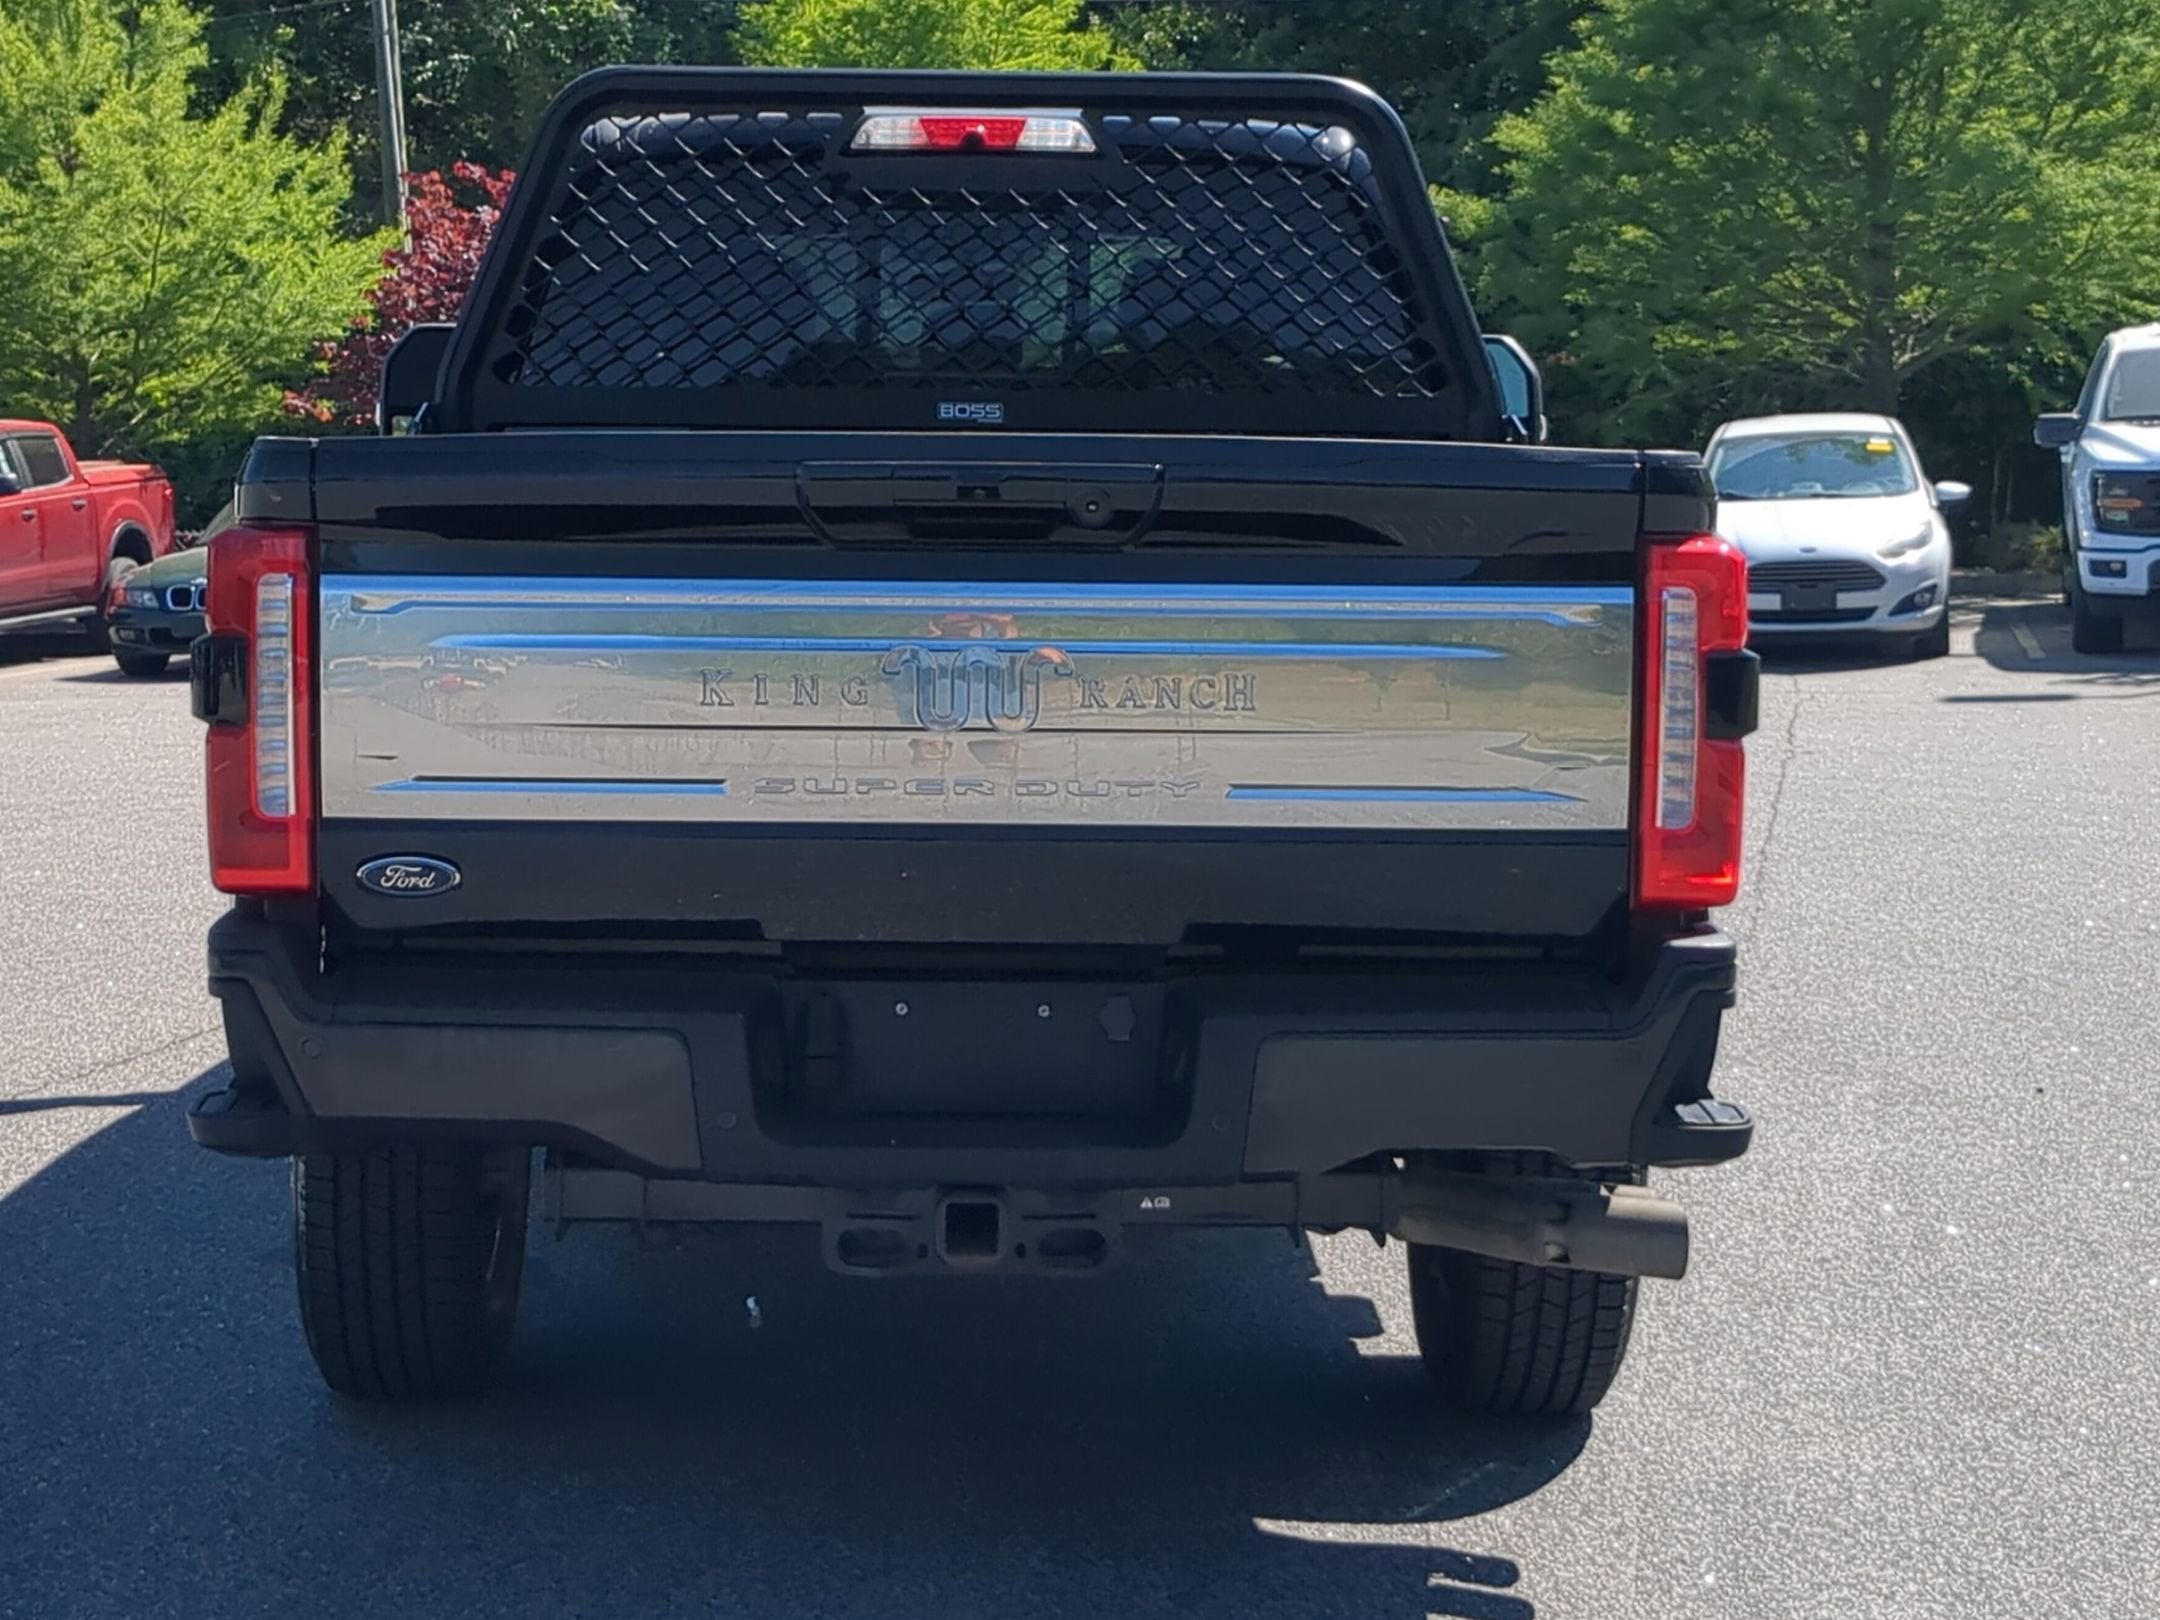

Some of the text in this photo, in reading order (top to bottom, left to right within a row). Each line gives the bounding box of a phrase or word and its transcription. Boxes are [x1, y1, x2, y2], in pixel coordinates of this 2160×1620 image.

[939, 403, 1001, 418] BOSS
[700, 667, 1258, 711] KING RANCH
[753, 776, 1201, 798] SUPER DUTY
[380, 864, 436, 888] Ford
